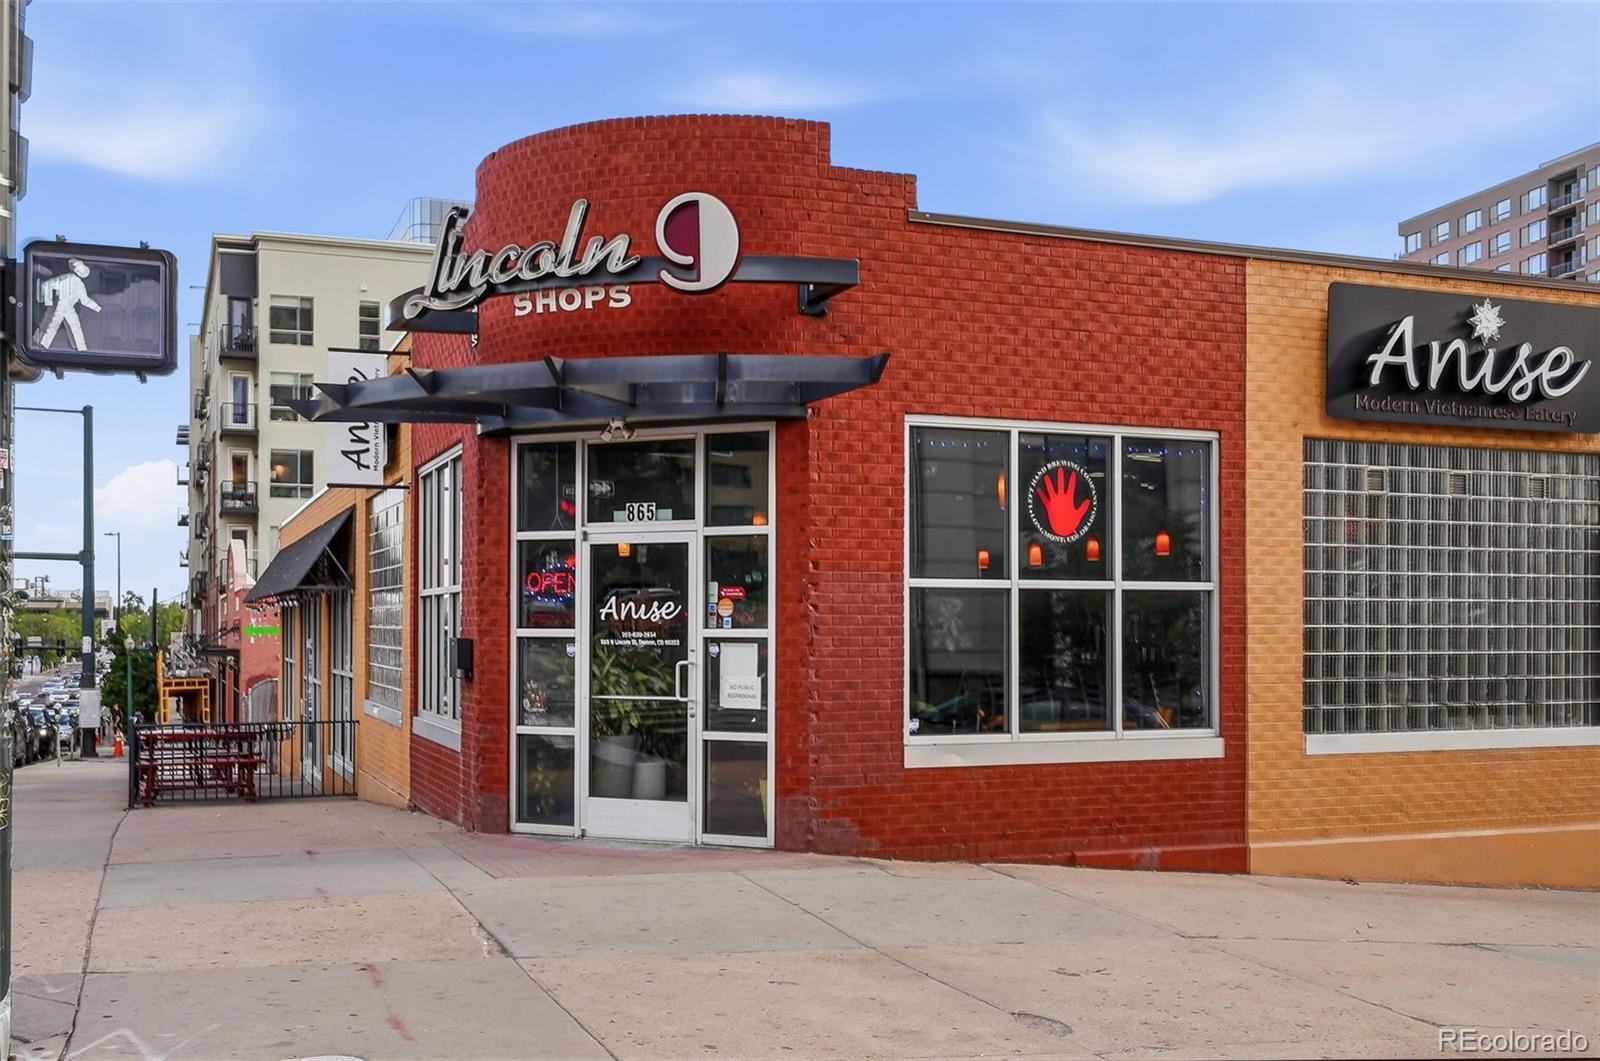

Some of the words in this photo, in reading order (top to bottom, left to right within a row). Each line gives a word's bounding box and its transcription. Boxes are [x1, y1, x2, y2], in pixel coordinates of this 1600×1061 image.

[403, 198, 641, 320] Lincoln
[655, 192, 740, 292] 9
[514, 285, 632, 316] SHOPS
[1366, 315, 1592, 403] Anise
[1355, 394, 1419, 414] Modern
[1424, 399, 1521, 420] Vietnamese
[1524, 406, 1577, 426] Eatery
[627, 504, 654, 521] 865
[527, 572, 575, 594] OPEN
[599, 596, 682, 622] Anise
